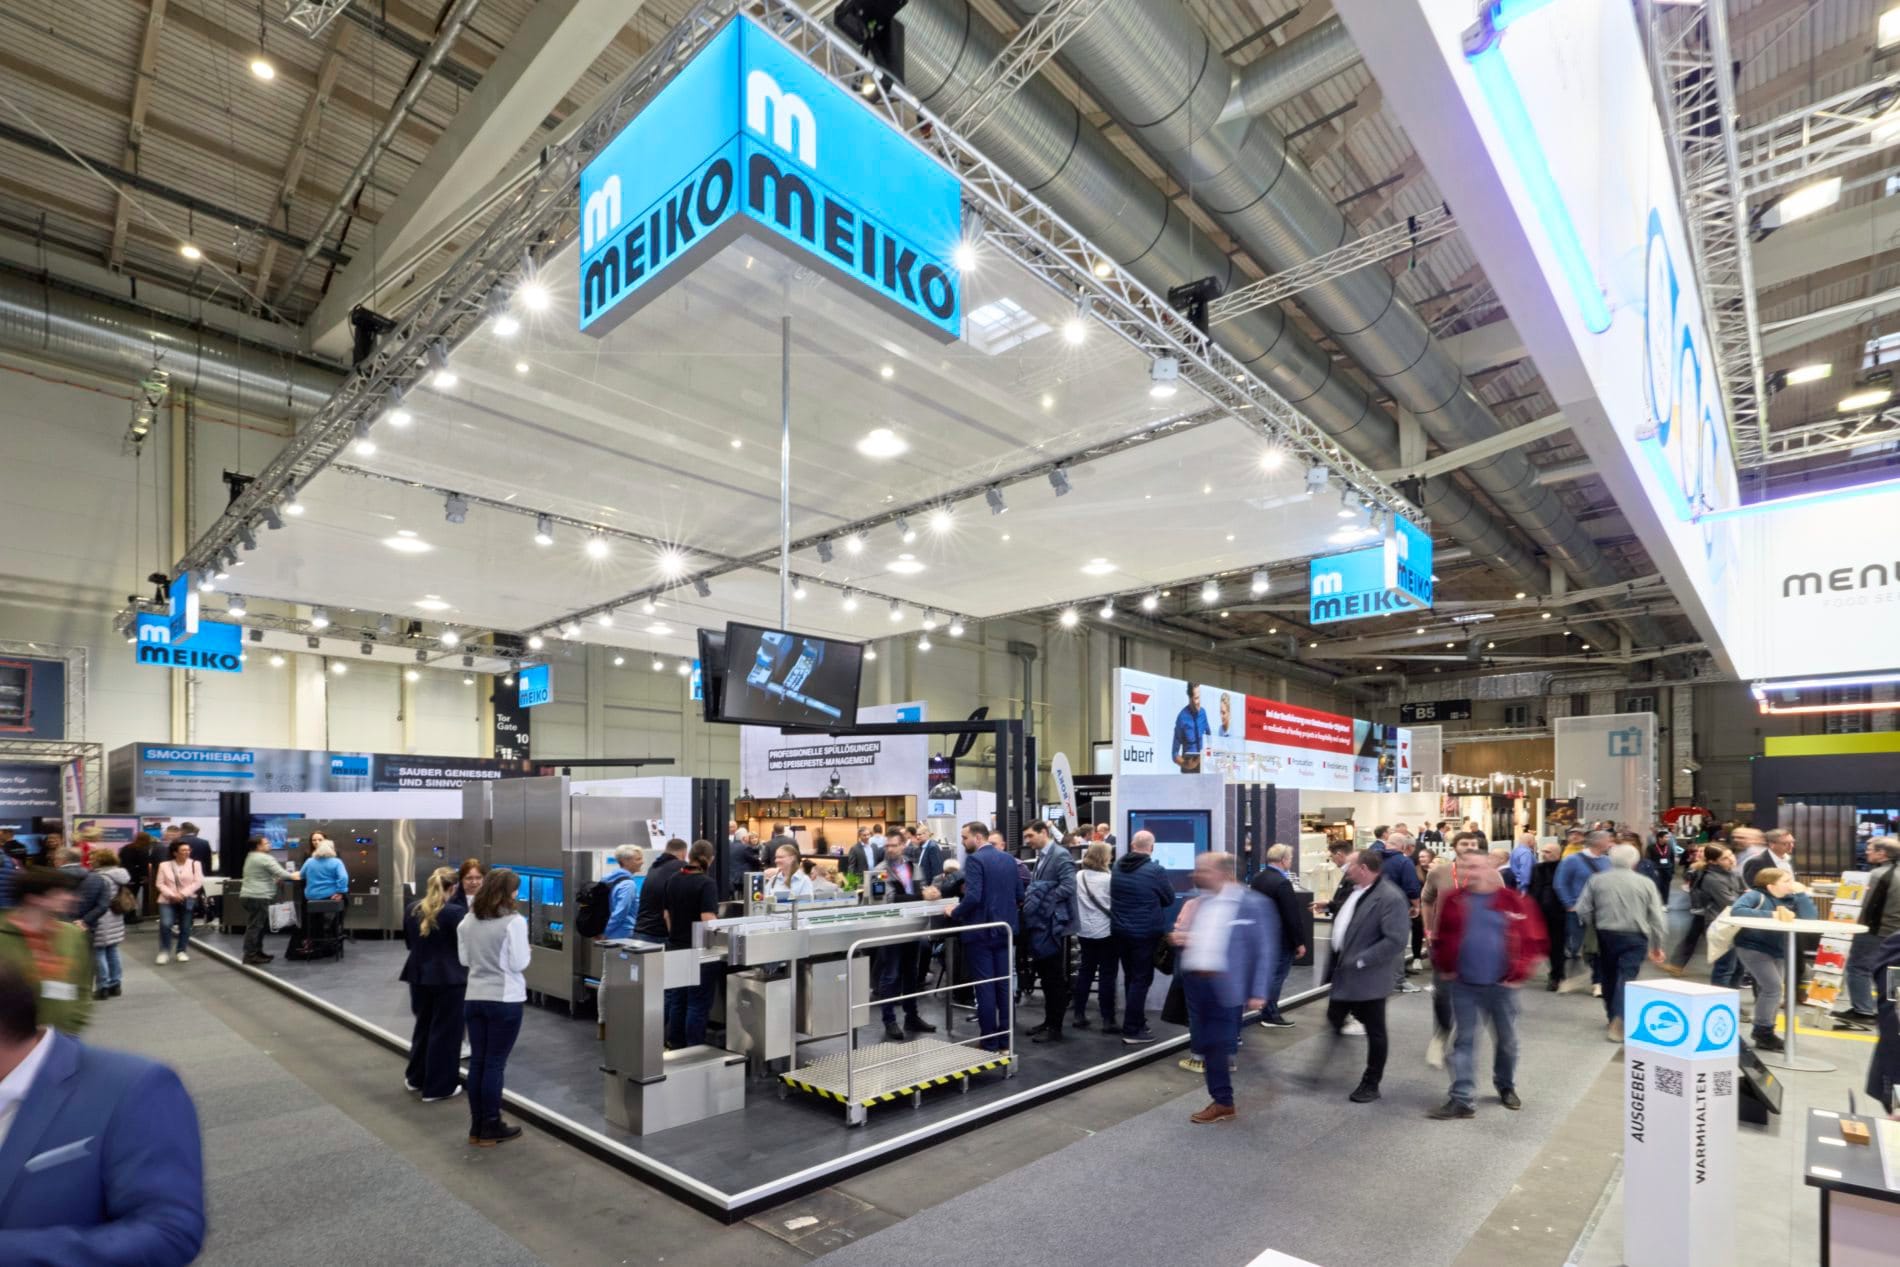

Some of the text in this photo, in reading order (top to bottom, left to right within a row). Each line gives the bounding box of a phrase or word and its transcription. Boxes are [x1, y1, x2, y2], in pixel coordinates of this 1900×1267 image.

[584, 158, 733, 320] MEIKO
[748, 153, 955, 320] MEIKO
[140, 646, 240, 670] MEIKO
[496, 714, 511, 722] Tor
[1415, 707, 1436, 719] B5
[497, 723, 518, 731] Gate
[516, 733, 529, 744] 10
[146, 749, 251, 762] SMOOTHIEBAR
[1123, 745, 1154, 763] ubert
[399, 767, 443, 777] SAUBER
[445, 769, 502, 778] GENIESSEN
[399, 778, 422, 787] UND
[1631, 1060, 1645, 1143] AUSGEBEN
[1695, 1072, 1707, 1184] WARMHALTEN
